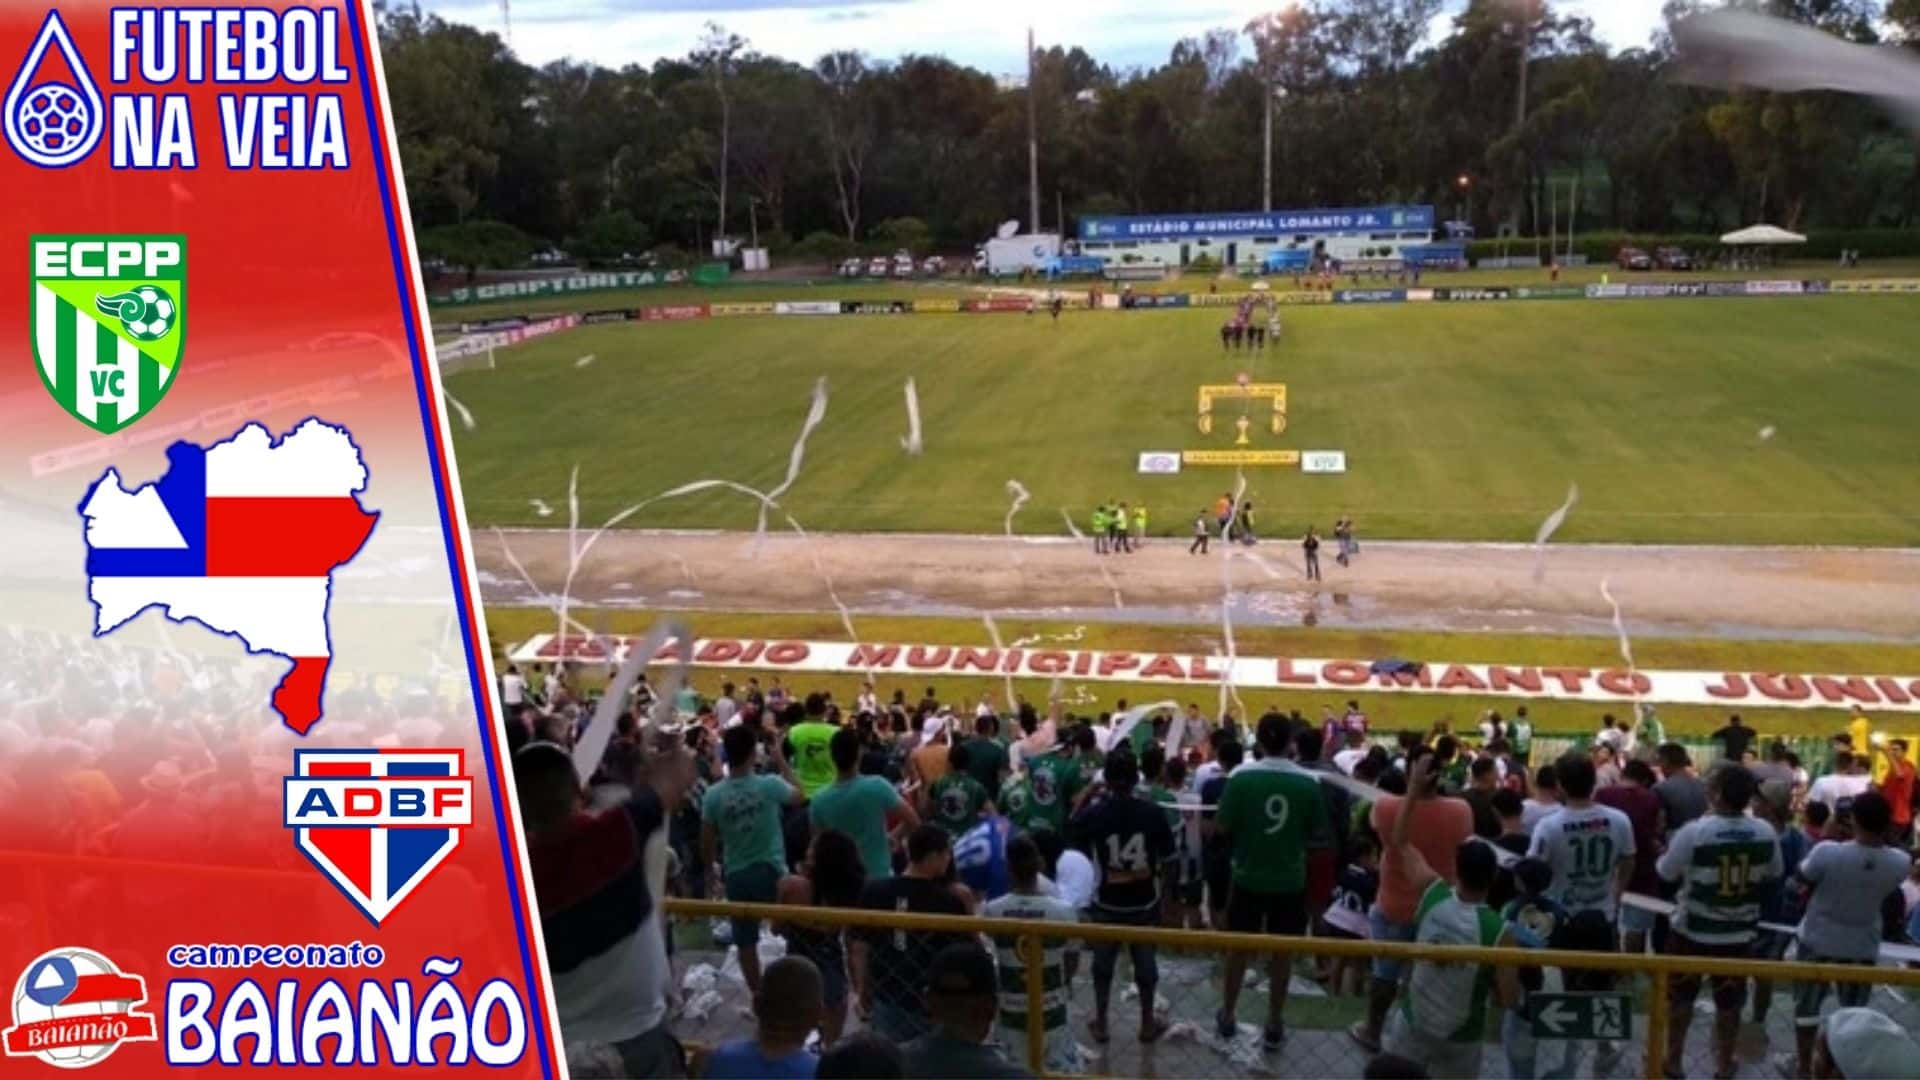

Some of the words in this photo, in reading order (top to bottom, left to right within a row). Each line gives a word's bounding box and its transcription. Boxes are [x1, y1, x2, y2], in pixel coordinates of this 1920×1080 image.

[1193, 217, 1274, 232] MUNICIPAL
[1279, 215, 1351, 229] LOMANTO
[847, 642, 1224, 681] MUNICIPAL
[1276, 656, 1652, 696] LOMANTO
[1264, 793, 1289, 835] 9
[1105, 832, 1147, 869] 14
[1567, 835, 1614, 881] 10
[1716, 853, 1750, 897] 11
